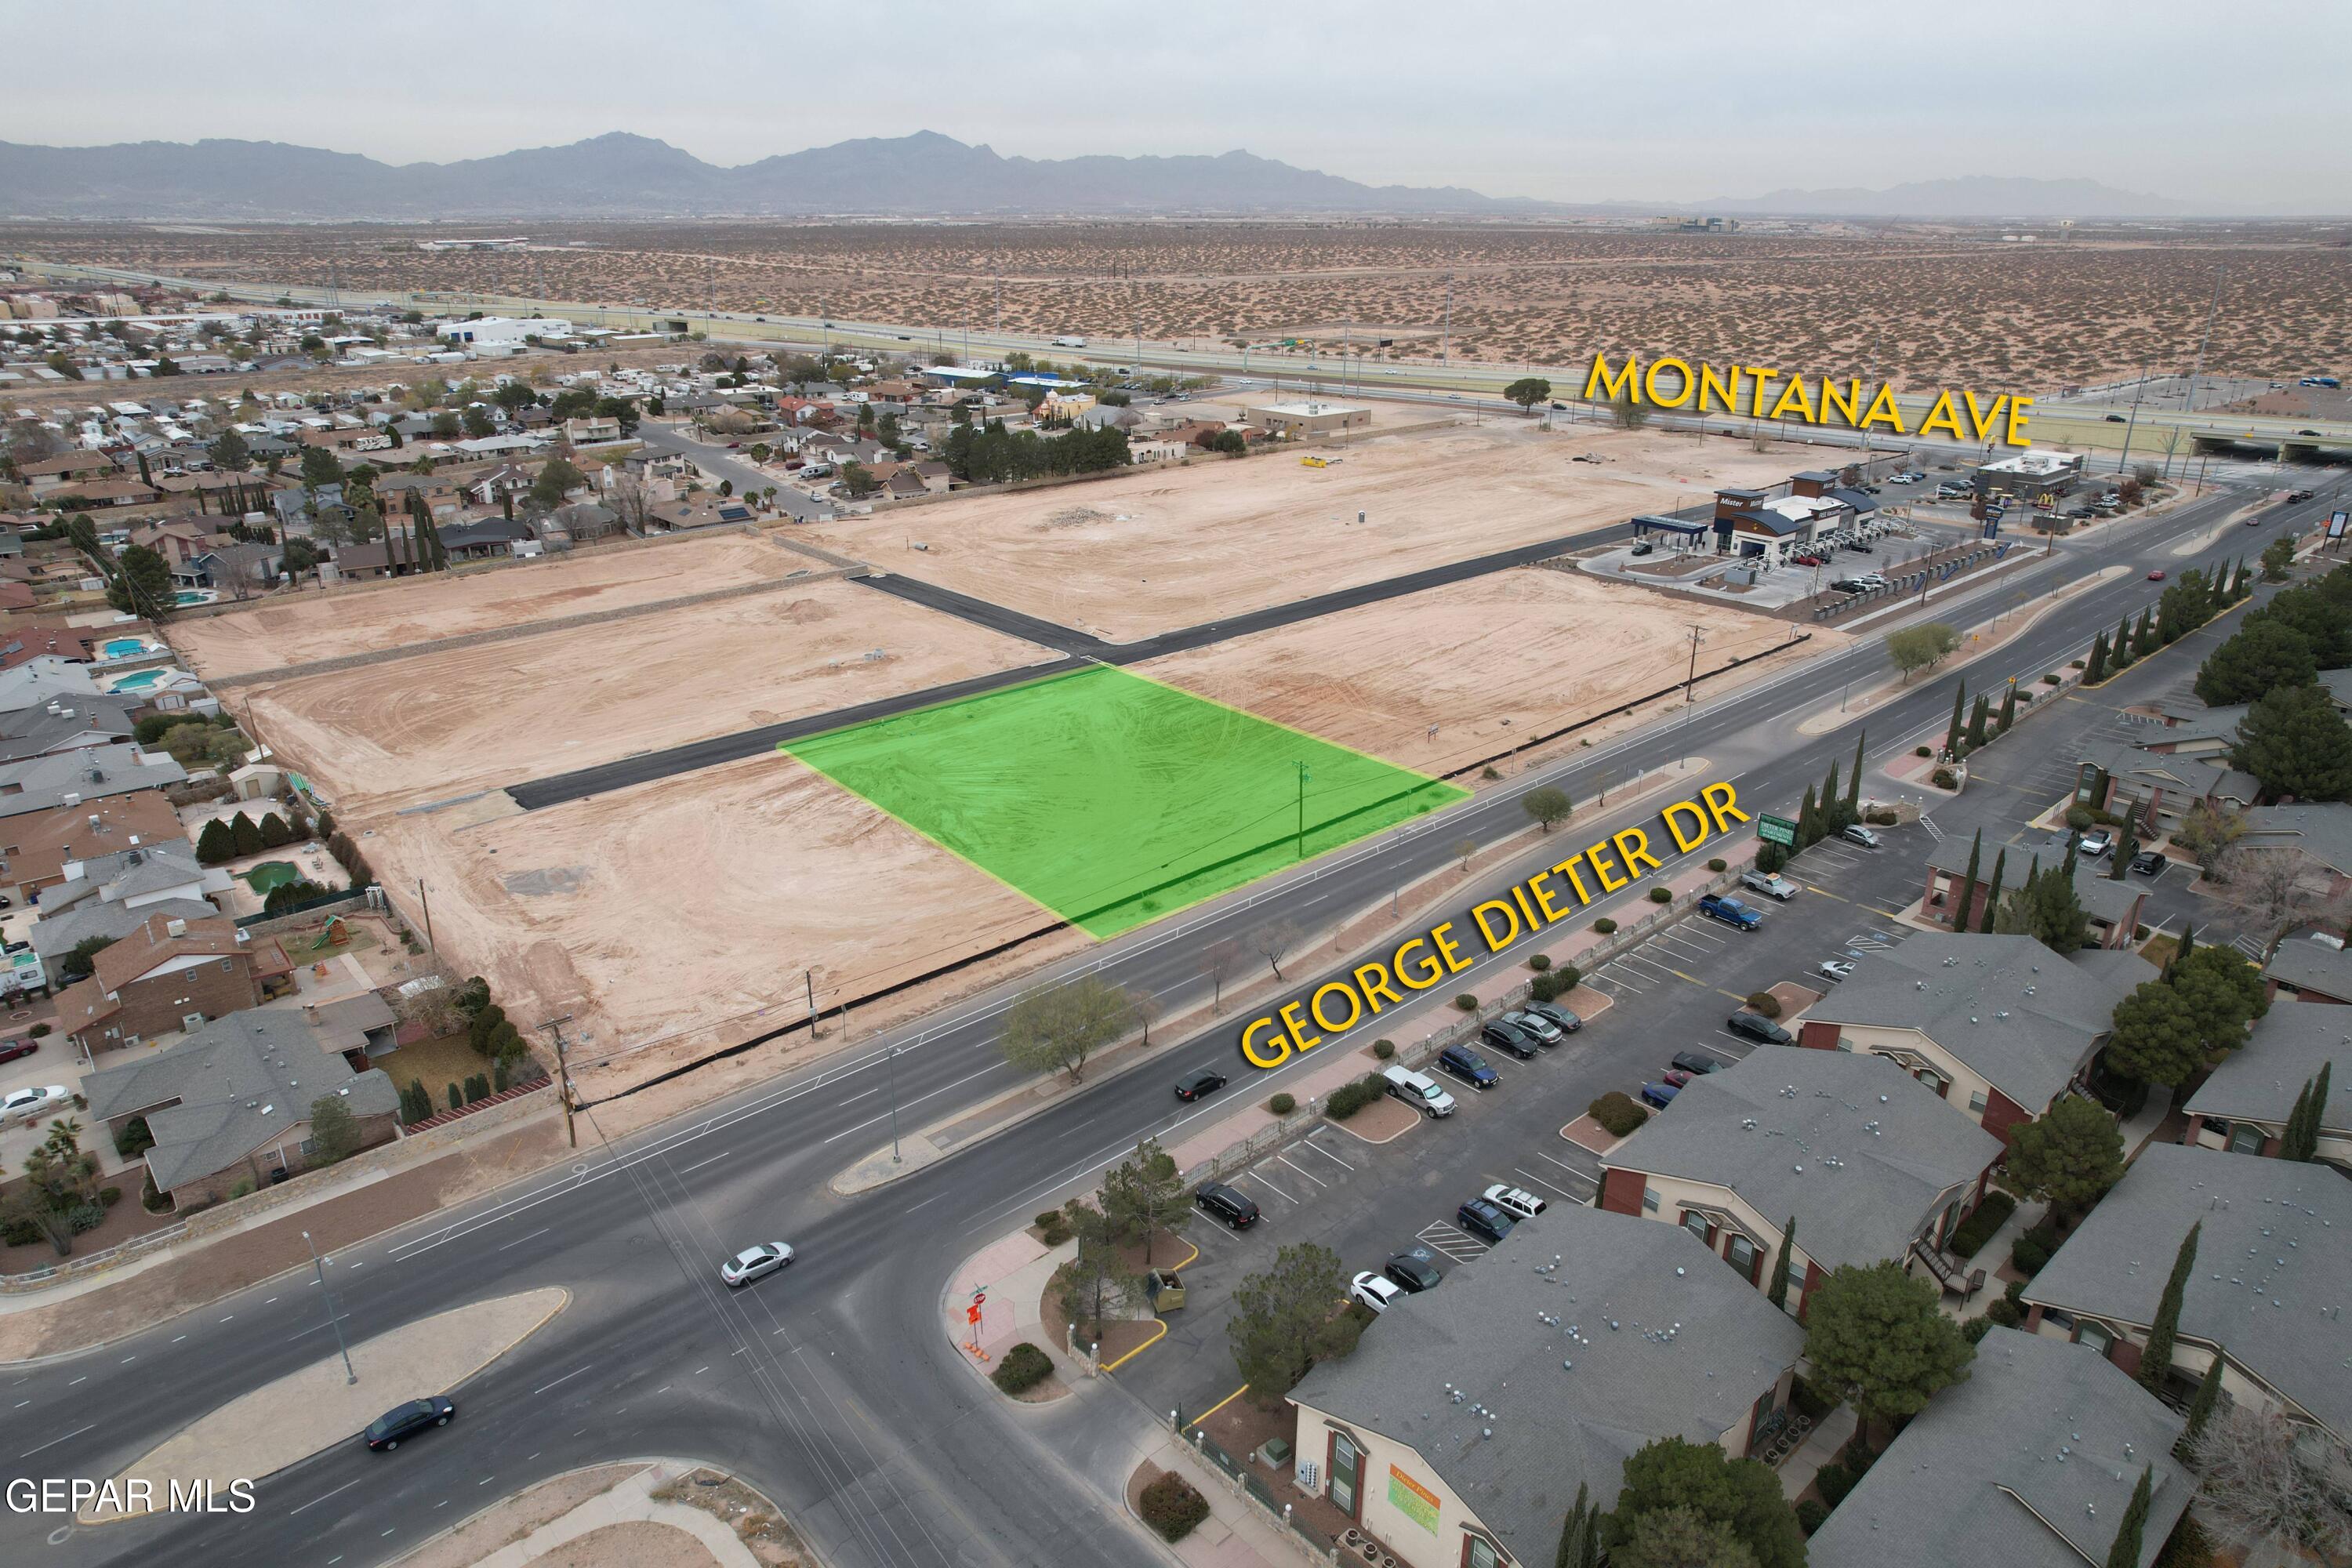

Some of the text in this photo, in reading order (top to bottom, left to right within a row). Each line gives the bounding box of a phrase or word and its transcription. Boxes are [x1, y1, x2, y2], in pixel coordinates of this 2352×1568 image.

[1719, 497, 1744, 507] Mister
[1749, 499, 1763, 508] Mister
[1761, 822, 1794, 836] DIETER PINES
[1762, 828, 1793, 840] APARTMENTS
[1396, 1471, 1434, 1503] Dieter Pines
